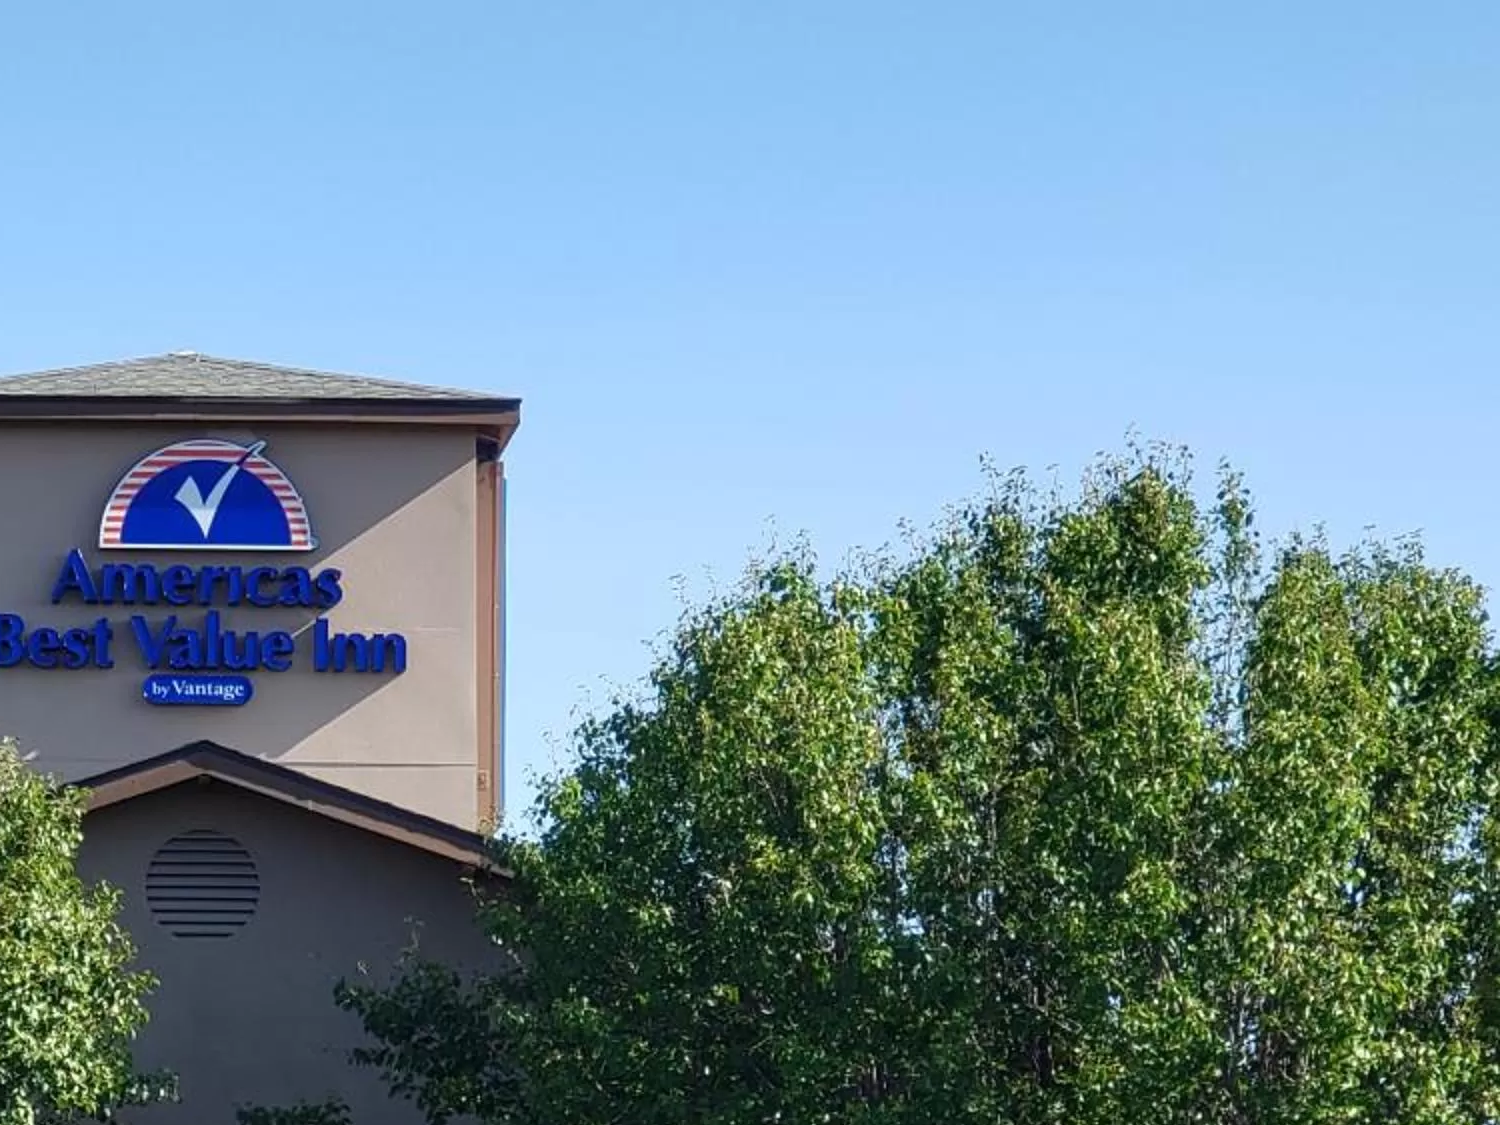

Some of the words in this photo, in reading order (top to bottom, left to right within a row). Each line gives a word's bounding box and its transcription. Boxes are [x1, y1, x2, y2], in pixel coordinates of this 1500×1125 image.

[51, 547, 343, 607] Americas
[130, 609, 295, 672] Value
[312, 616, 407, 673] Inn
[151, 681, 169, 699] by
[174, 679, 245, 700] Vantage
